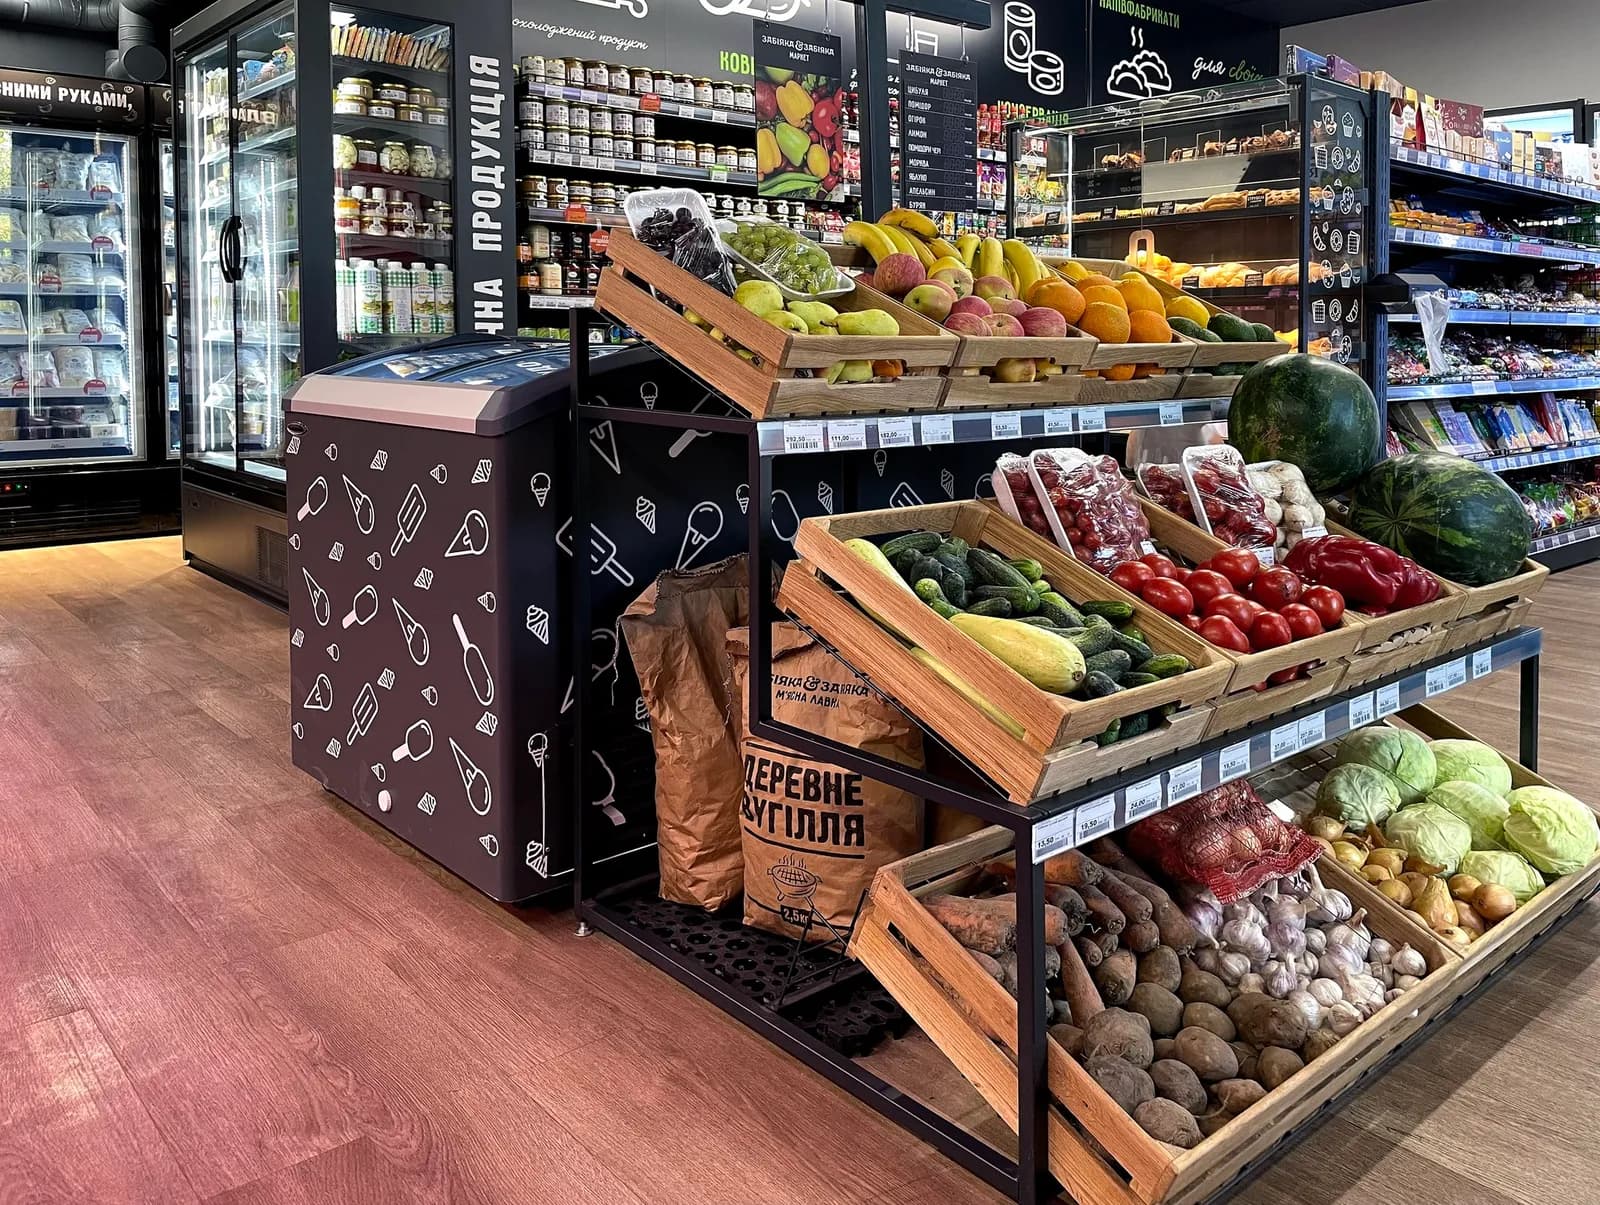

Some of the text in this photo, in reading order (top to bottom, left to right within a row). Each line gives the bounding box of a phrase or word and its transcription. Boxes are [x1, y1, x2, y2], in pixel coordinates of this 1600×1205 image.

[599, 34, 649, 51] продукт
[789, 51, 810, 62] МАРКЕТ
[1191, 57, 1226, 80] для
[0, 81, 133, 111] НИМИ РУКАМИ,
[469, 54, 506, 252] ПРОДУКЦІЯ
[744, 753, 865, 807] ДЕРЕВНЕ
